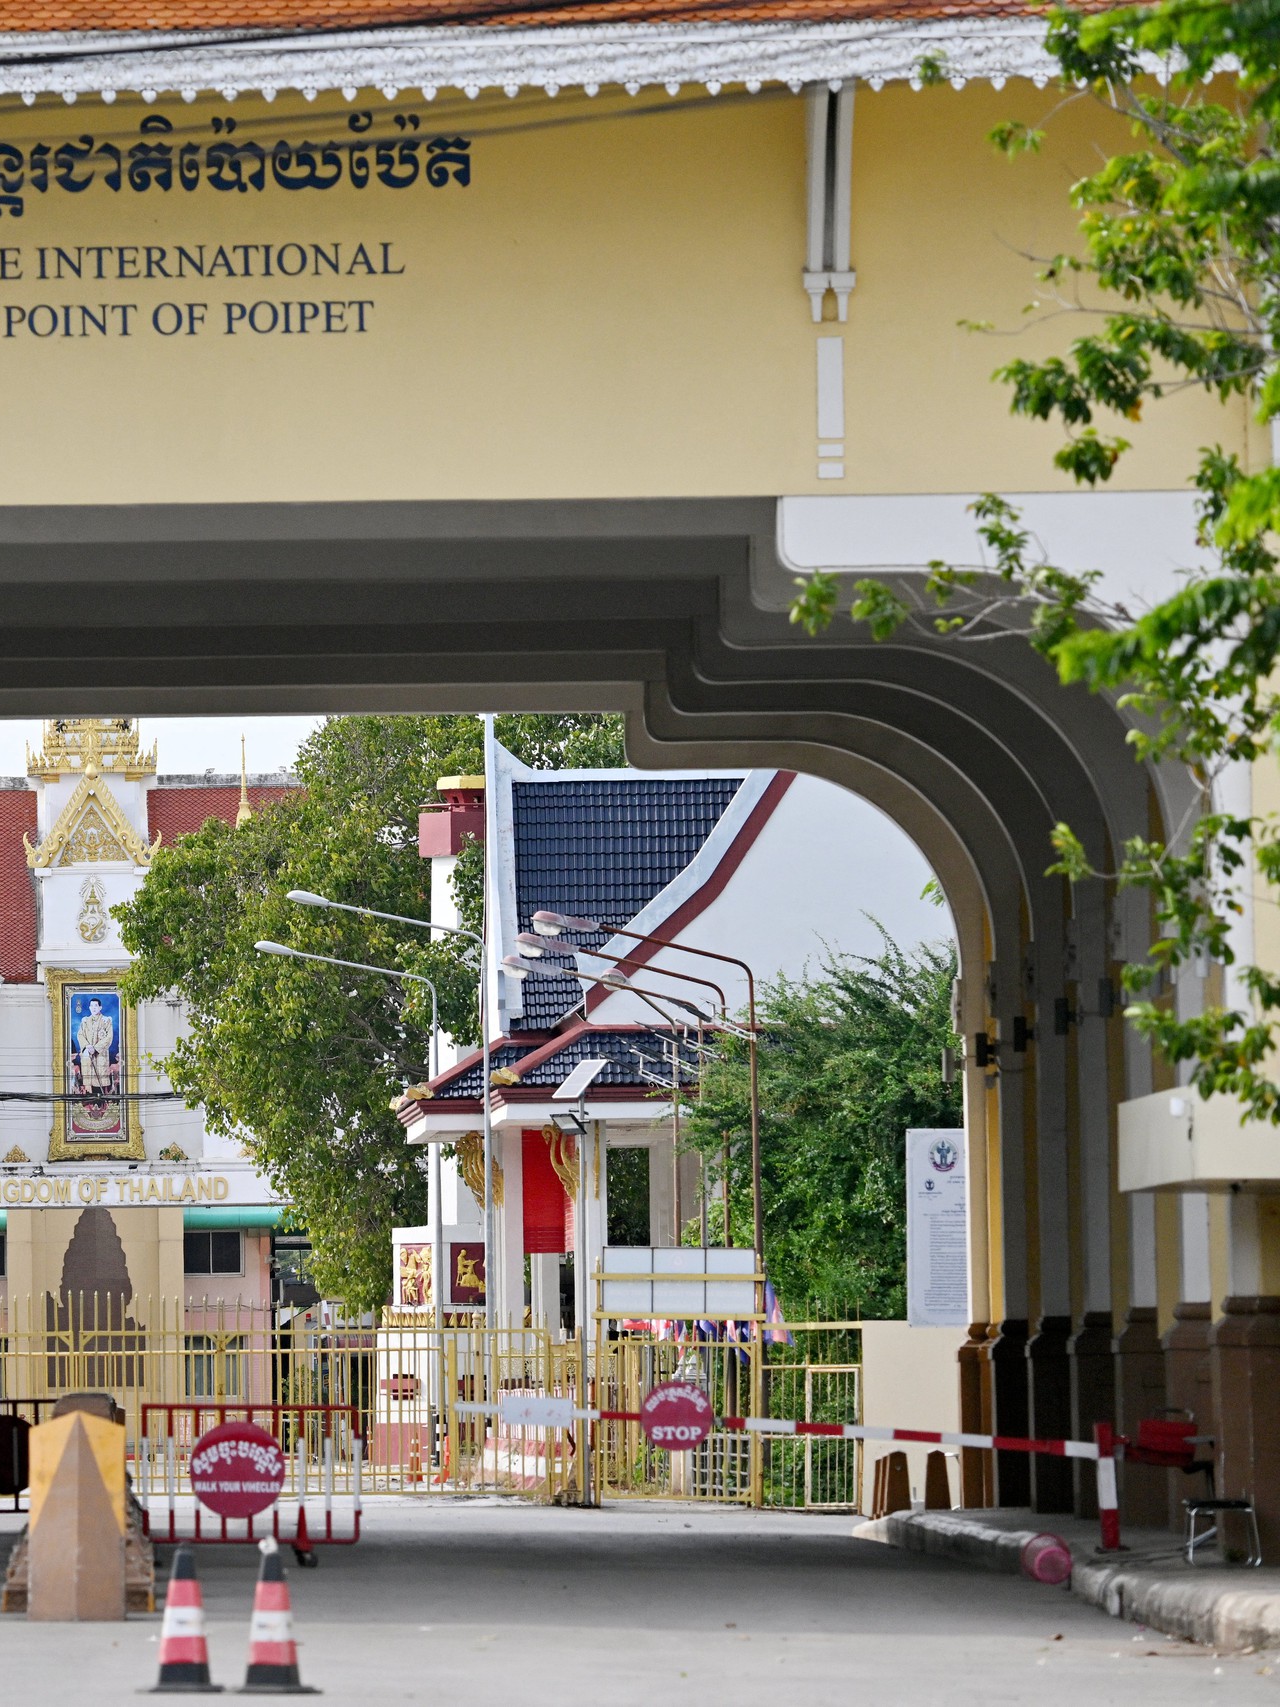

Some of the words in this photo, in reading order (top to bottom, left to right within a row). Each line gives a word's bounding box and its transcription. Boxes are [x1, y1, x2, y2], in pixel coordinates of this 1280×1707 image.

[37, 242, 406, 279] INTERNATIONAL
[3, 304, 137, 338] POINT
[151, 301, 208, 337] OF
[224, 300, 375, 335] POIPET
[78, 1177, 108, 1204] OF
[115, 1176, 229, 1202] THAILAND
[652, 1426, 701, 1440] STOP
[194, 1481, 218, 1493] WALK
[218, 1481, 241, 1493] YOUR
